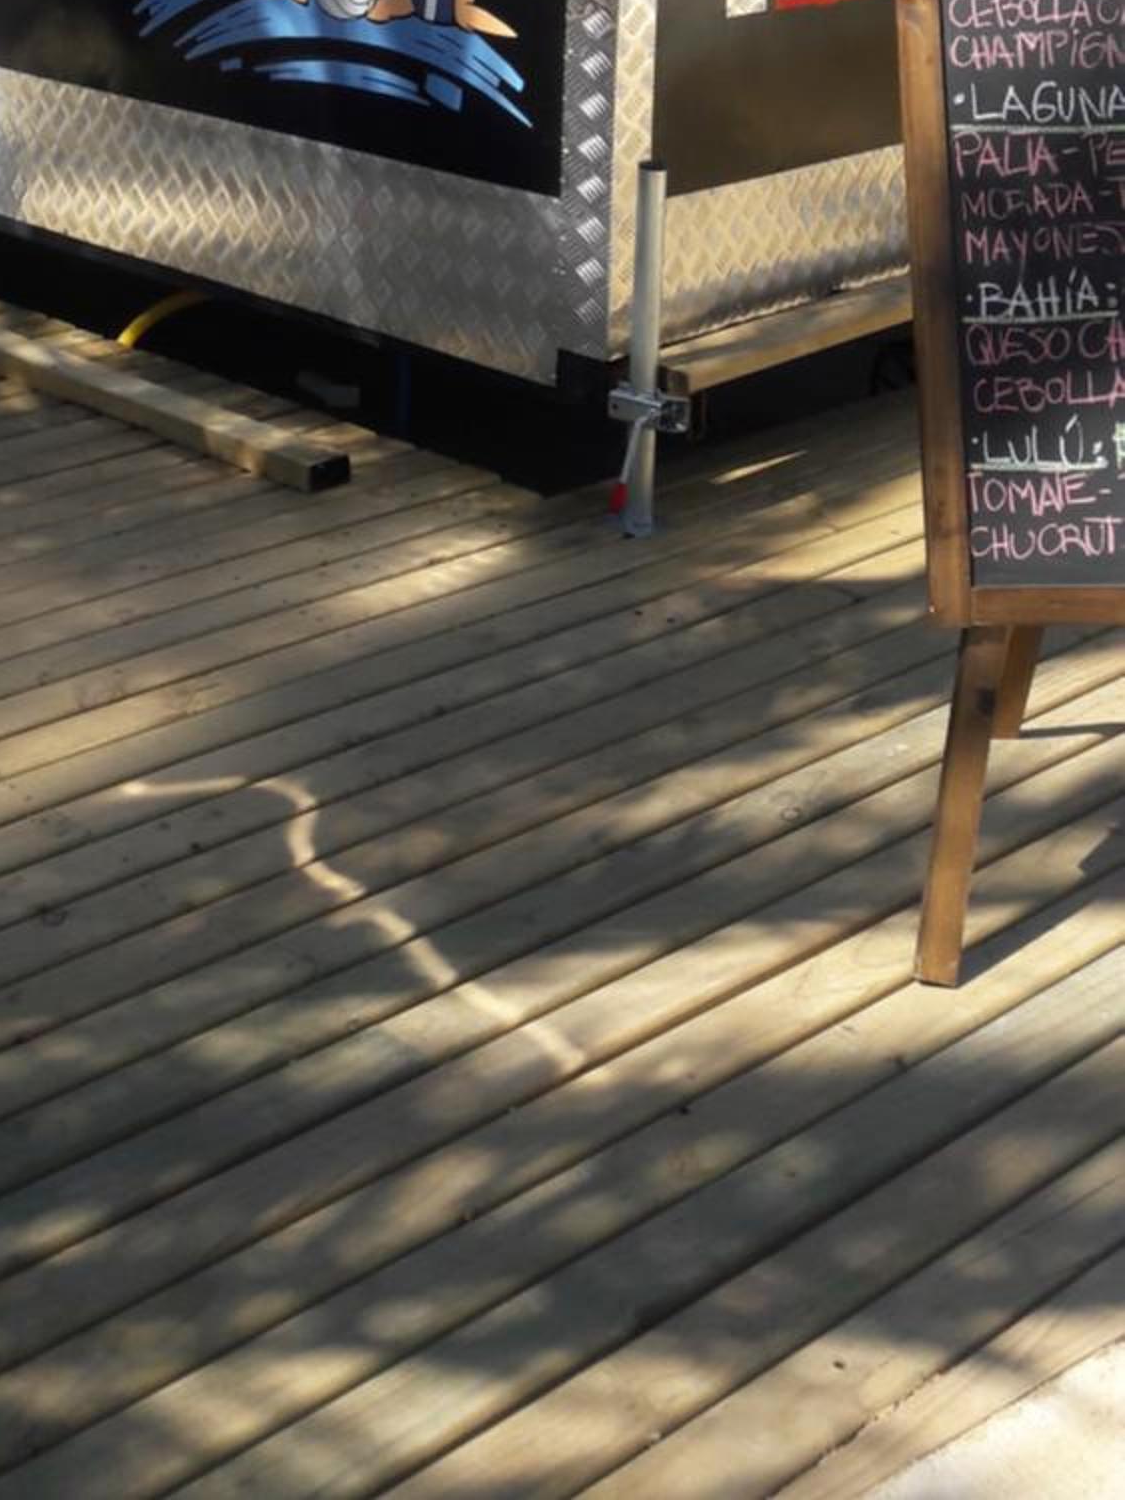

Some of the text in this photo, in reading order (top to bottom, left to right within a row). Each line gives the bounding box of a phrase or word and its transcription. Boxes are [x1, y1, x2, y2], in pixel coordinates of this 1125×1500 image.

[953, 130, 1059, 178] PALTA
[966, 323, 1071, 366] QUESO
[968, 470, 1096, 516] TOMATE
[970, 516, 1122, 561] CHUCRUT
